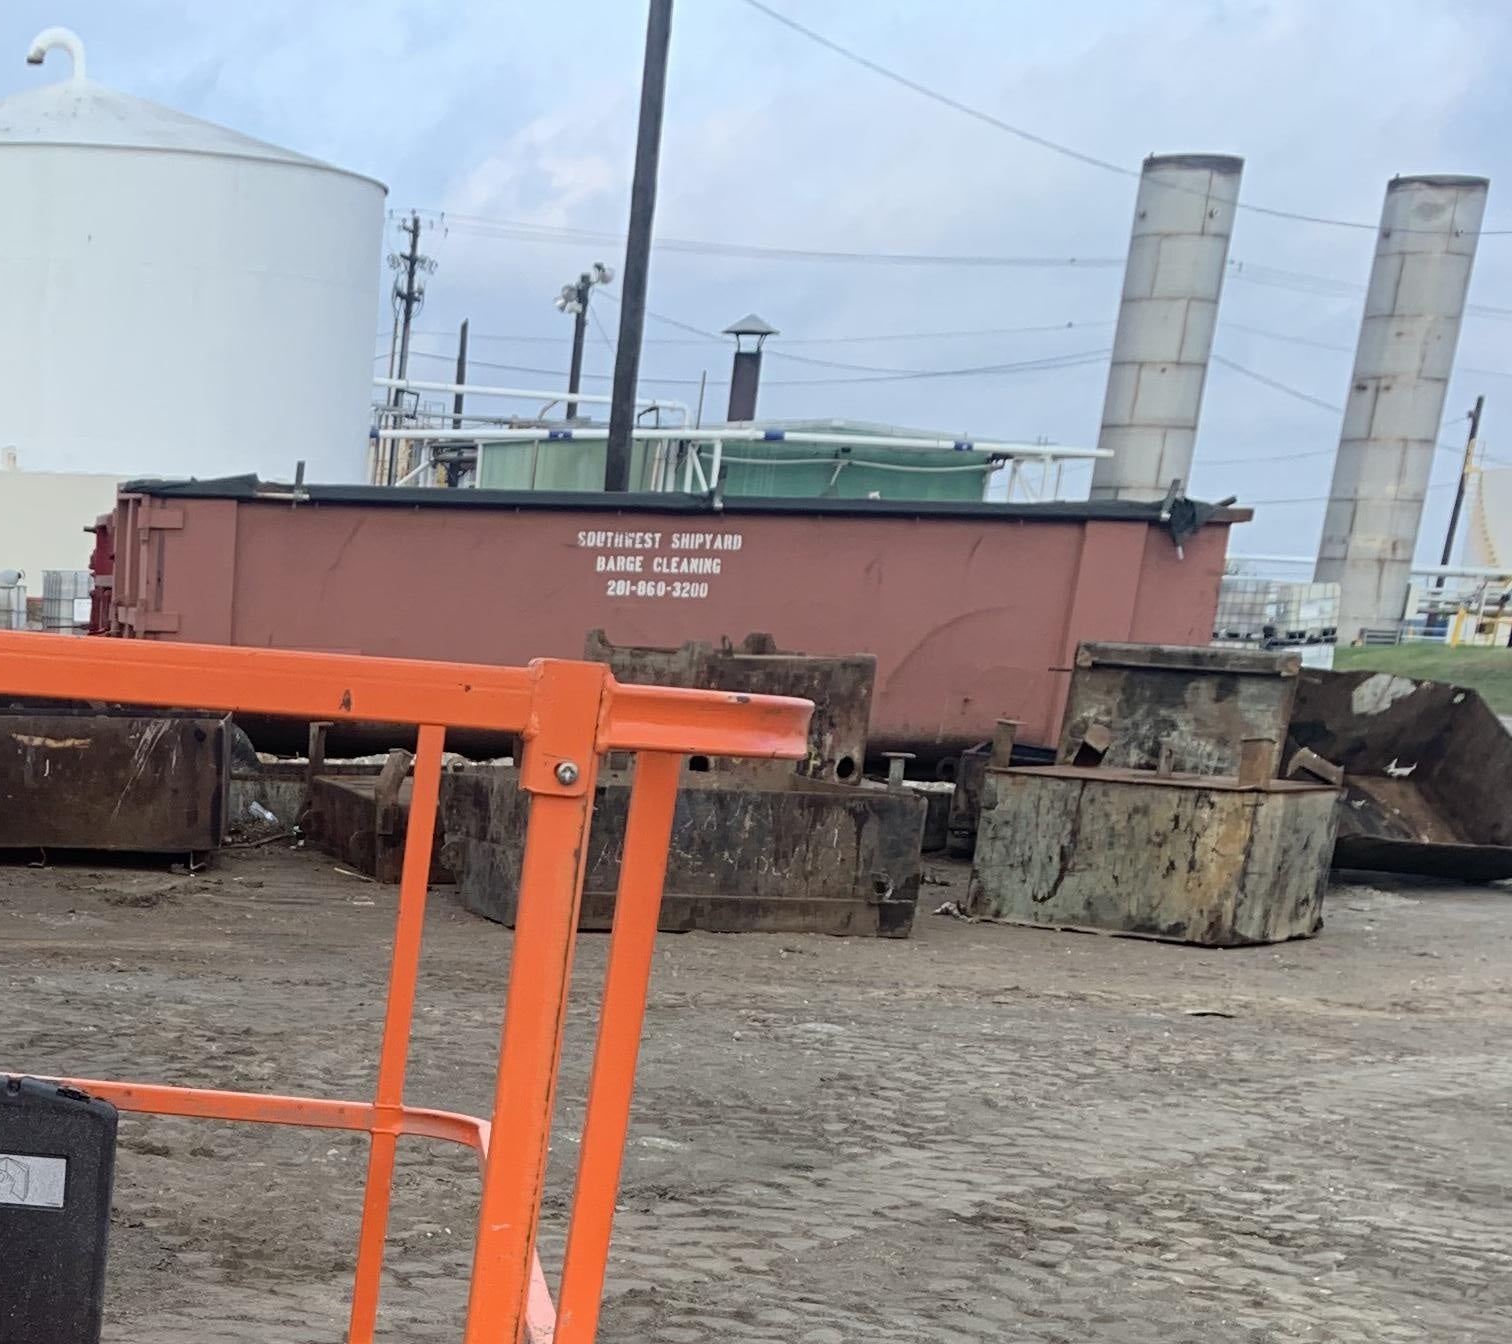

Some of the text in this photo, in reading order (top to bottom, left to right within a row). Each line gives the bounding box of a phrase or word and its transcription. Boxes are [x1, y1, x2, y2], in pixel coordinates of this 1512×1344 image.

[577, 531, 742, 550] SOUTHWEST SHIPYARD
[596, 555, 721, 574] BARGE CLEANING
